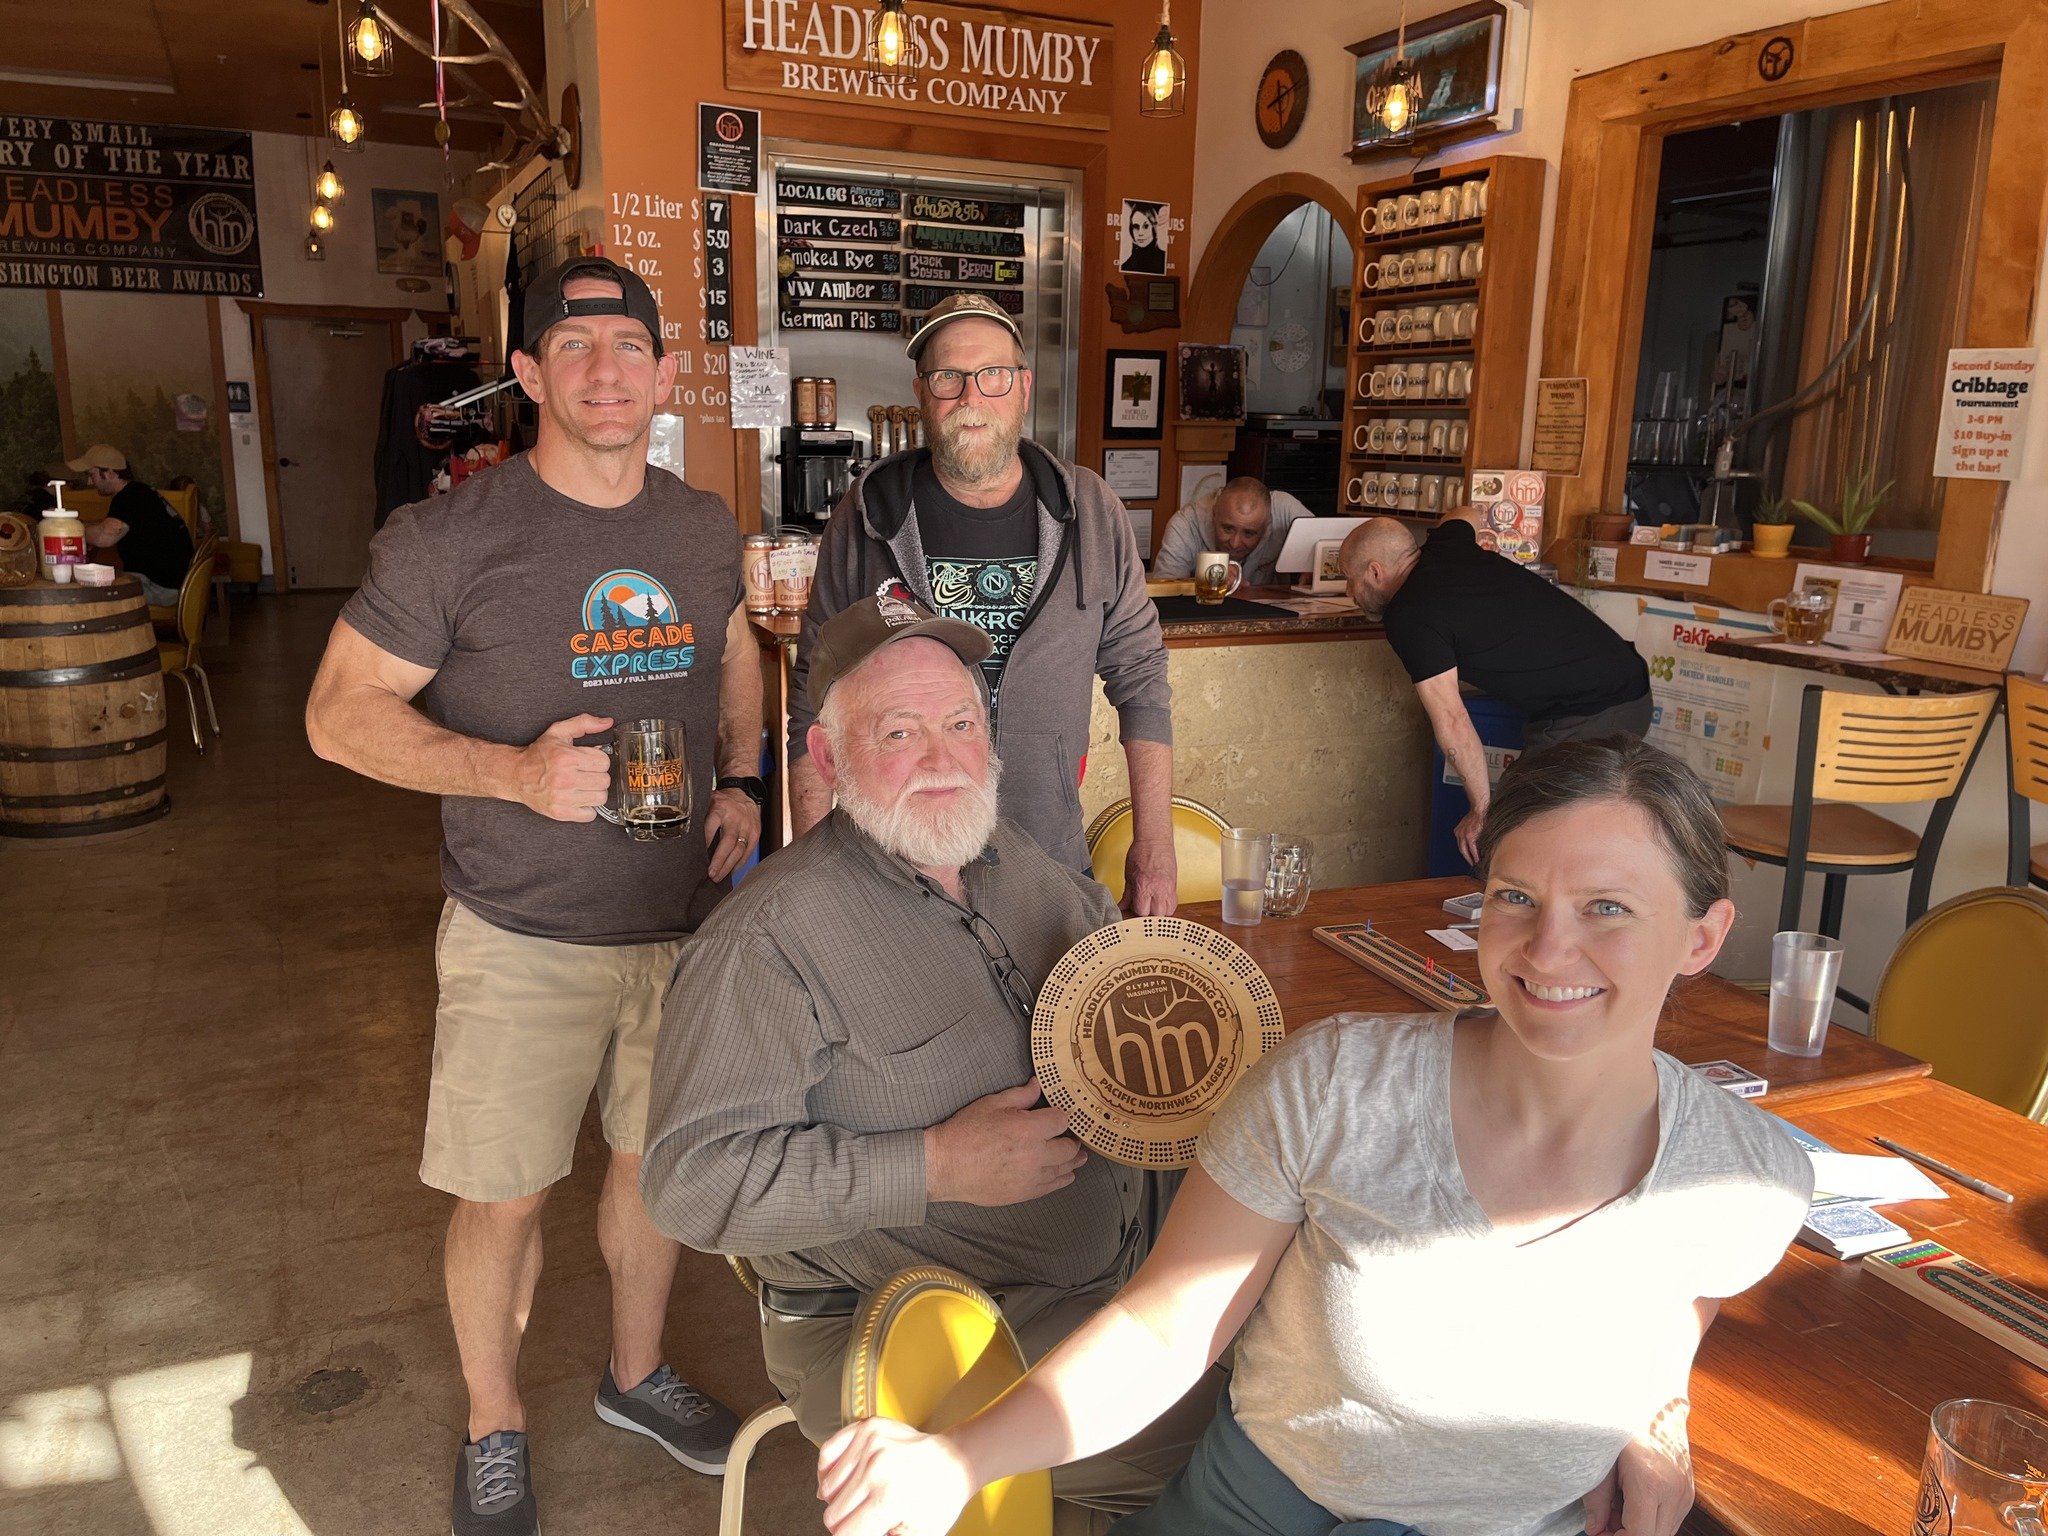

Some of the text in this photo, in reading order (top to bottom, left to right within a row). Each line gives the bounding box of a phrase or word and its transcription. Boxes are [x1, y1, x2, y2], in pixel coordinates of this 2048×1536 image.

[743, 0, 1100, 86] HEADLSS MUMBY
[781, 61, 1068, 115] BREWING COMPANY
[71, 121, 153, 147] SMALL
[54, 143, 89, 170] OF
[104, 146, 163, 176] THE
[173, 151, 251, 181] YEAR
[6, 176, 174, 209] EADLESS
[778, 183, 825, 201] LOCAL
[851, 195, 885, 208] Lager
[612, 193, 724, 223] 1/2 Liter $ 7
[0, 202, 174, 244] MUMBY
[784, 218, 823, 236] Dark
[829, 218, 878, 238] Czech
[613, 224, 632, 247] 12
[637, 230, 662, 249] oz.
[693, 228, 701, 251] $
[0, 239, 177, 259] REWING COMPANY
[638, 259, 662, 276] oz.
[694, 256, 701, 279] $
[712, 258, 724, 276] 3
[845, 250, 874, 270] Rye
[0, 262, 252, 294] SHINGTON BEER AWARDS
[699, 286, 726, 310] $ 15
[820, 282, 876, 301] Amber
[699, 317, 706, 340] $
[708, 320, 730, 339] 16
[781, 311, 843, 330] German
[850, 312, 876, 330] Pils
[703, 351, 727, 376] $20
[744, 348, 776, 360] WINE
[1952, 360, 2035, 374] Second Sunday
[672, 385, 696, 406] To
[702, 386, 727, 406] Go
[754, 385, 772, 394] NA
[1952, 376, 2028, 399] Cribbage
[1956, 398, 2018, 408] Tournament
[1986, 415, 2004, 424] PM
[1954, 430, 2012, 444] $10 Buy-in
[1952, 445, 2009, 459] Sign up at
[1956, 461, 2002, 473] the bar!
[1903, 602, 2016, 631] HEADLESS
[570, 624, 695, 654] CASCADE
[1673, 624, 1733, 646] PakTe
[1895, 618, 2010, 654] MUMBY
[572, 646, 696, 680] EXPRESS
[582, 679, 604, 688] 2023
[648, 670, 688, 681] MARATHON
[627, 764, 682, 776] HEADLESS
[628, 771, 682, 788] MUMBY
[1125, 978, 1166, 991] OLYMPIA
[1126, 985, 1168, 999] WASHINGTON
[1082, 981, 1115, 1039] HEADLESS
[1114, 964, 1160, 985] MUMBY
[1160, 964, 1217, 1000] BREWING
[1100, 1055, 1229, 1112] PACIFIC NORTHWEST LAGERS
